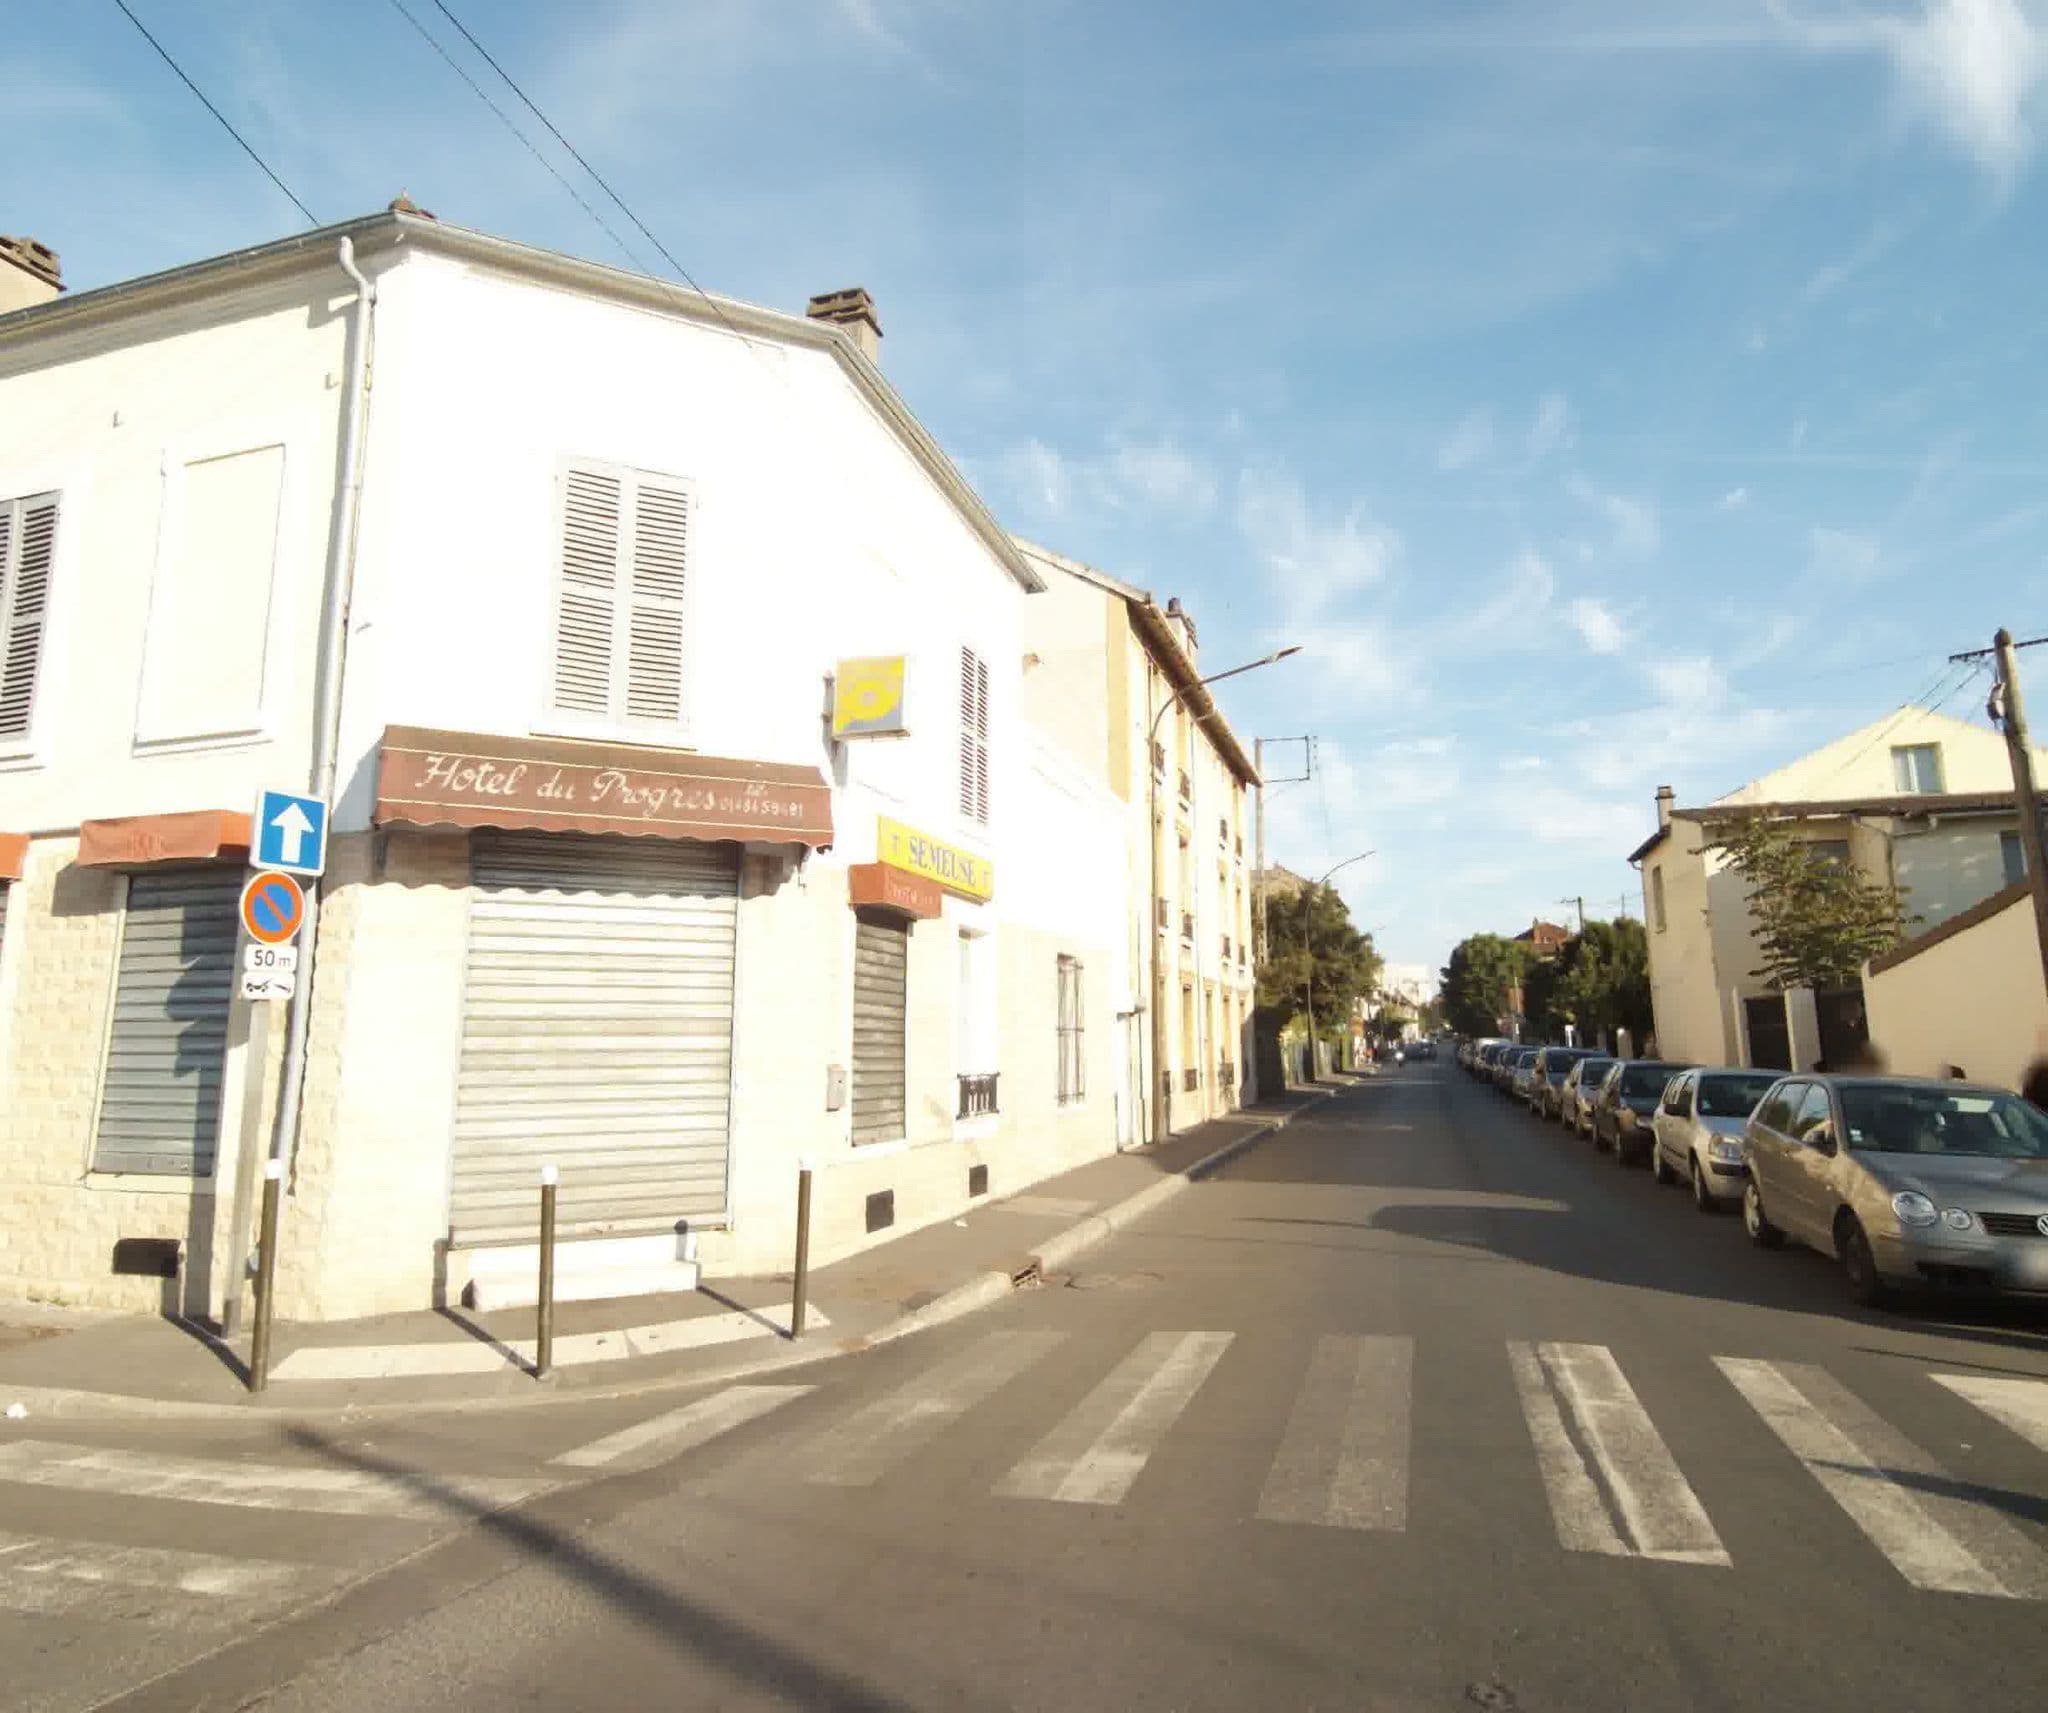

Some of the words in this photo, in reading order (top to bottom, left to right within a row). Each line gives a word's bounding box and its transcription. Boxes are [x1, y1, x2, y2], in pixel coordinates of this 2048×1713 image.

[415, 755, 528, 796] Hotel
[537, 768, 576, 800] du
[254, 949, 276, 967] 50
[279, 957, 291, 968] m
